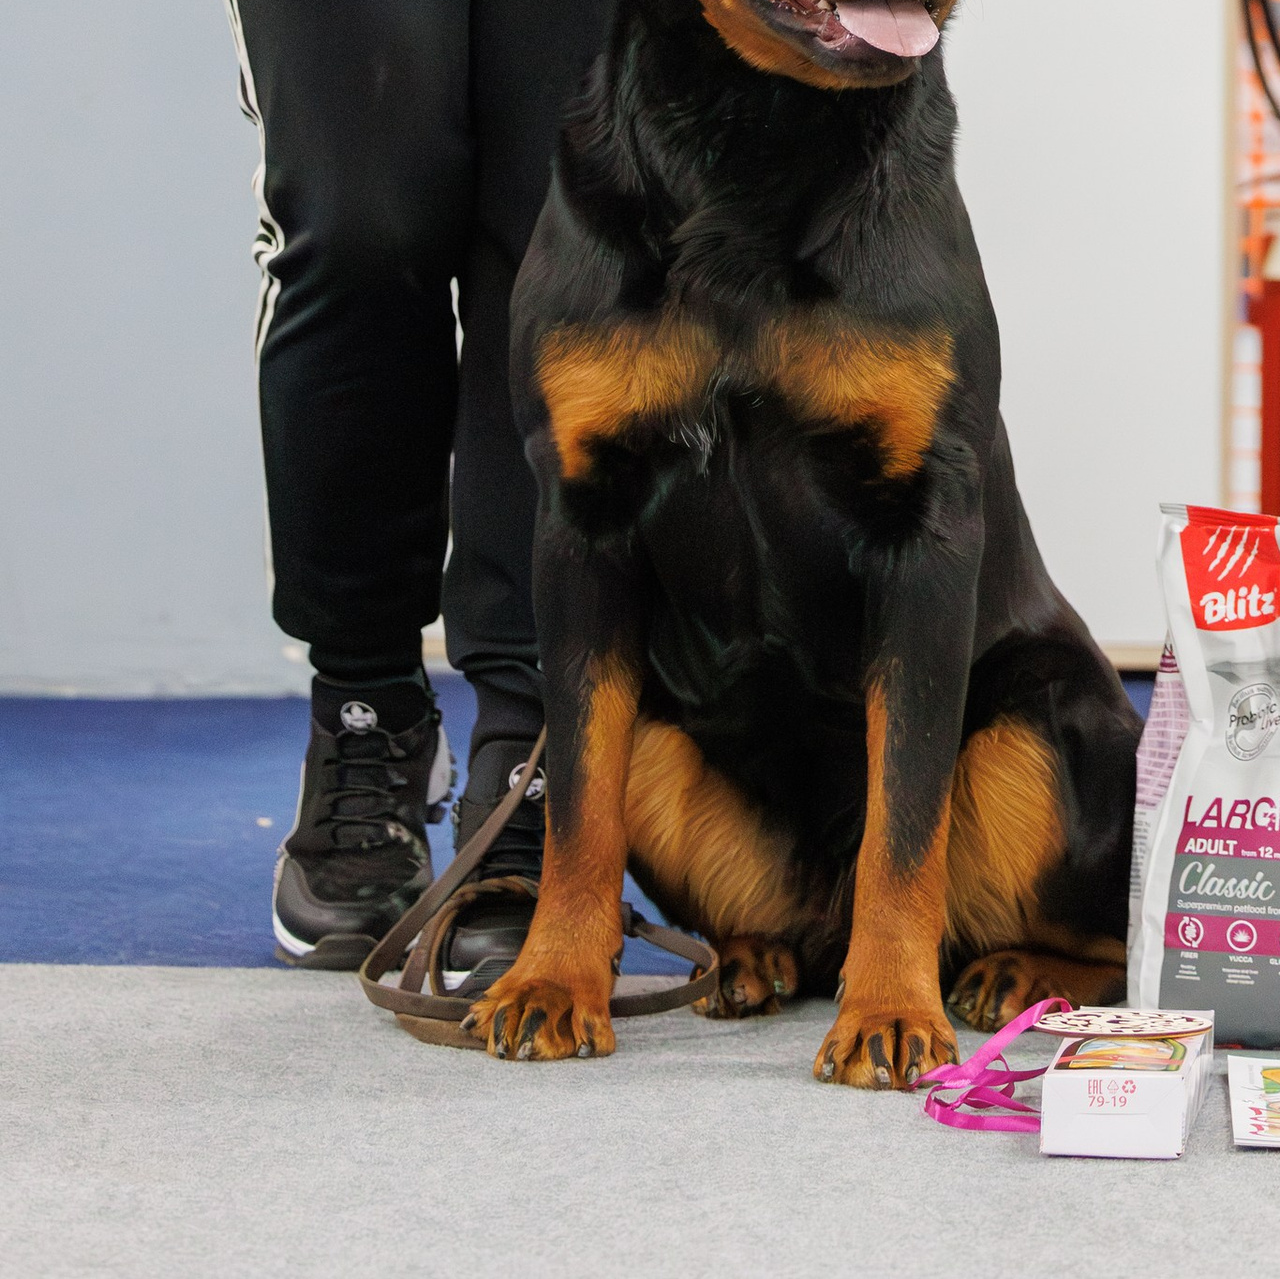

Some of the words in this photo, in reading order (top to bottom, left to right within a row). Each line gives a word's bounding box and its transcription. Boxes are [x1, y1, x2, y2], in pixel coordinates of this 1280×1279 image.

[1200, 584, 1275, 625] Blitz
[1184, 837, 1238, 856] ADULT
[1258, 846, 1273, 858] 12
[1179, 861, 1276, 901] Classic
[1177, 899, 1233, 913] Superpremium
[1233, 904, 1266, 916] petfood
[1088, 1095, 1127, 1108] 79-19
